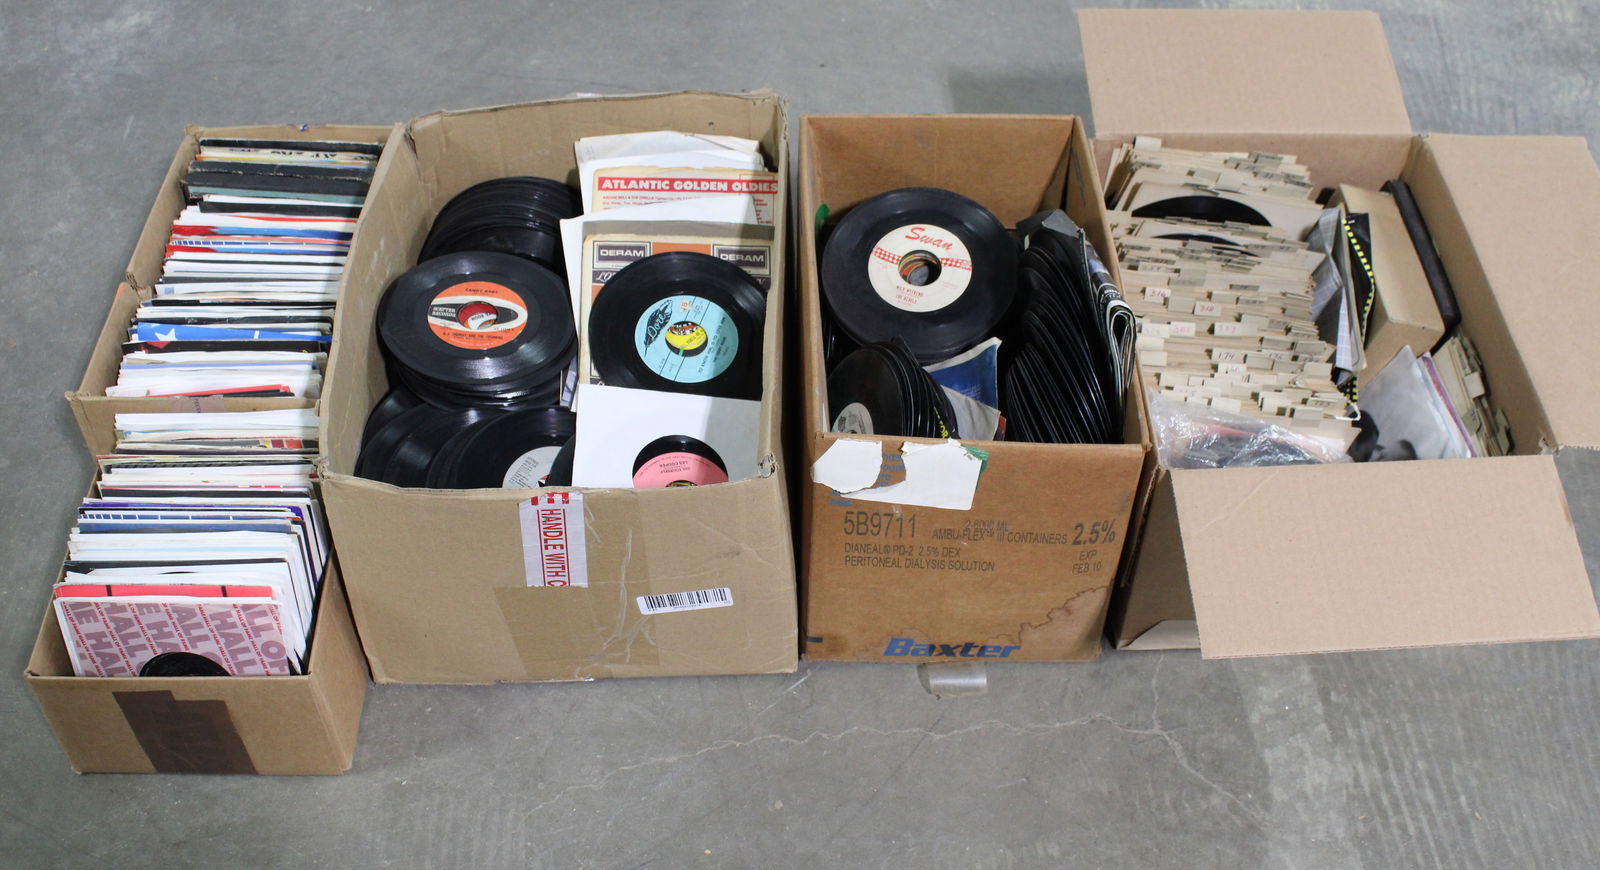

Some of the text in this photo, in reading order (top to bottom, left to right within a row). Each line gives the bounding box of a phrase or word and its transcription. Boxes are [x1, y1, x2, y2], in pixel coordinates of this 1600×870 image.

[602, 179, 778, 193] ATLANTIC GOLDEN OLDIES
[905, 227, 952, 250] Swan
[600, 249, 644, 258] DERAM
[720, 253, 764, 262] DERAM
[541, 508, 564, 551] HANDLE
[844, 512, 916, 539] 5B9711
[1072, 518, 1116, 546] 2.5%
[1007, 531, 1068, 544] CONTAINERS
[892, 545, 914, 556] PD-2
[919, 546, 940, 557] 2.5%
[942, 546, 960, 558] DEX
[1080, 550, 1098, 561] EXP
[544, 552, 566, 577] WITH
[844, 556, 995, 572] PERITONEAL DIALYSIS SOLUTION
[1072, 564, 1090, 574] FEB
[209, 610, 258, 674] HALL
[883, 637, 1021, 658] Baxter
